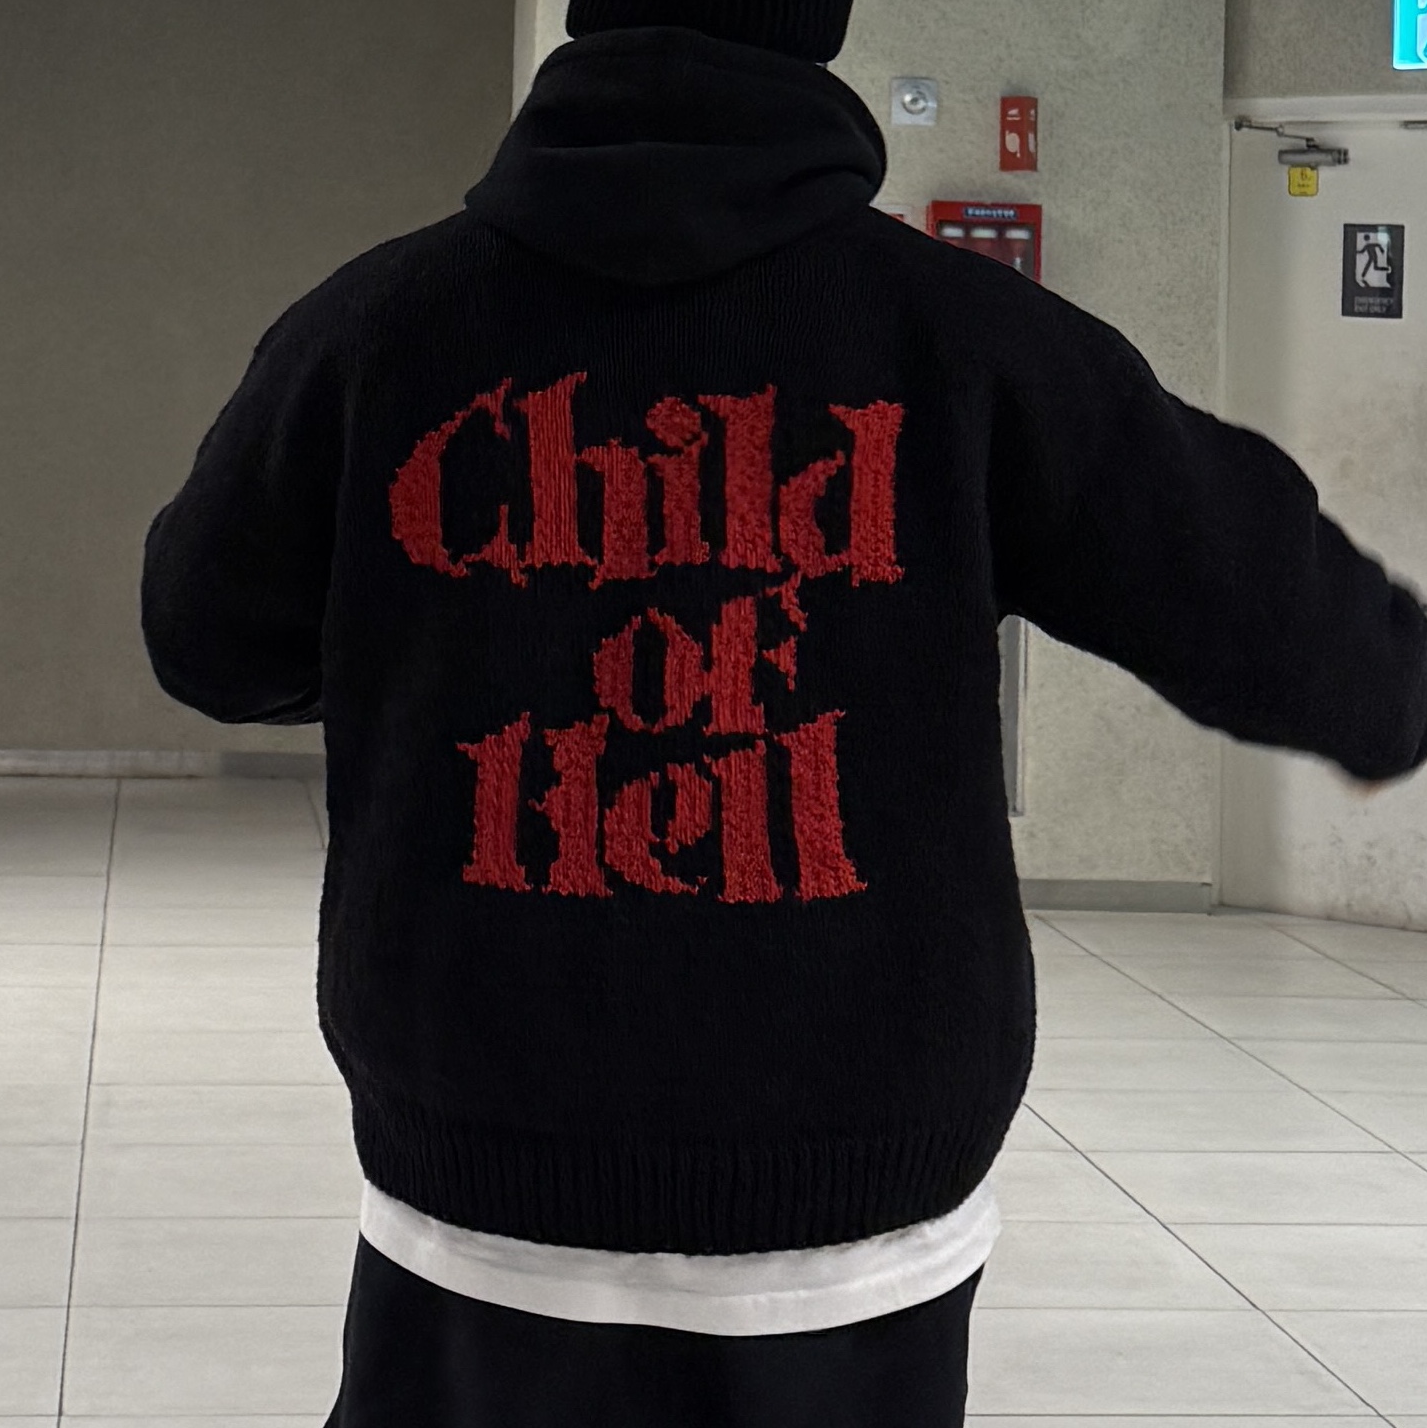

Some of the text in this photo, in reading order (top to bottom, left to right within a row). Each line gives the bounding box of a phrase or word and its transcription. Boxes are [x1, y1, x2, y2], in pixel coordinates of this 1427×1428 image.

[389, 371, 905, 589] Child
[593, 572, 808, 736] of
[455, 709, 868, 904] Hell
